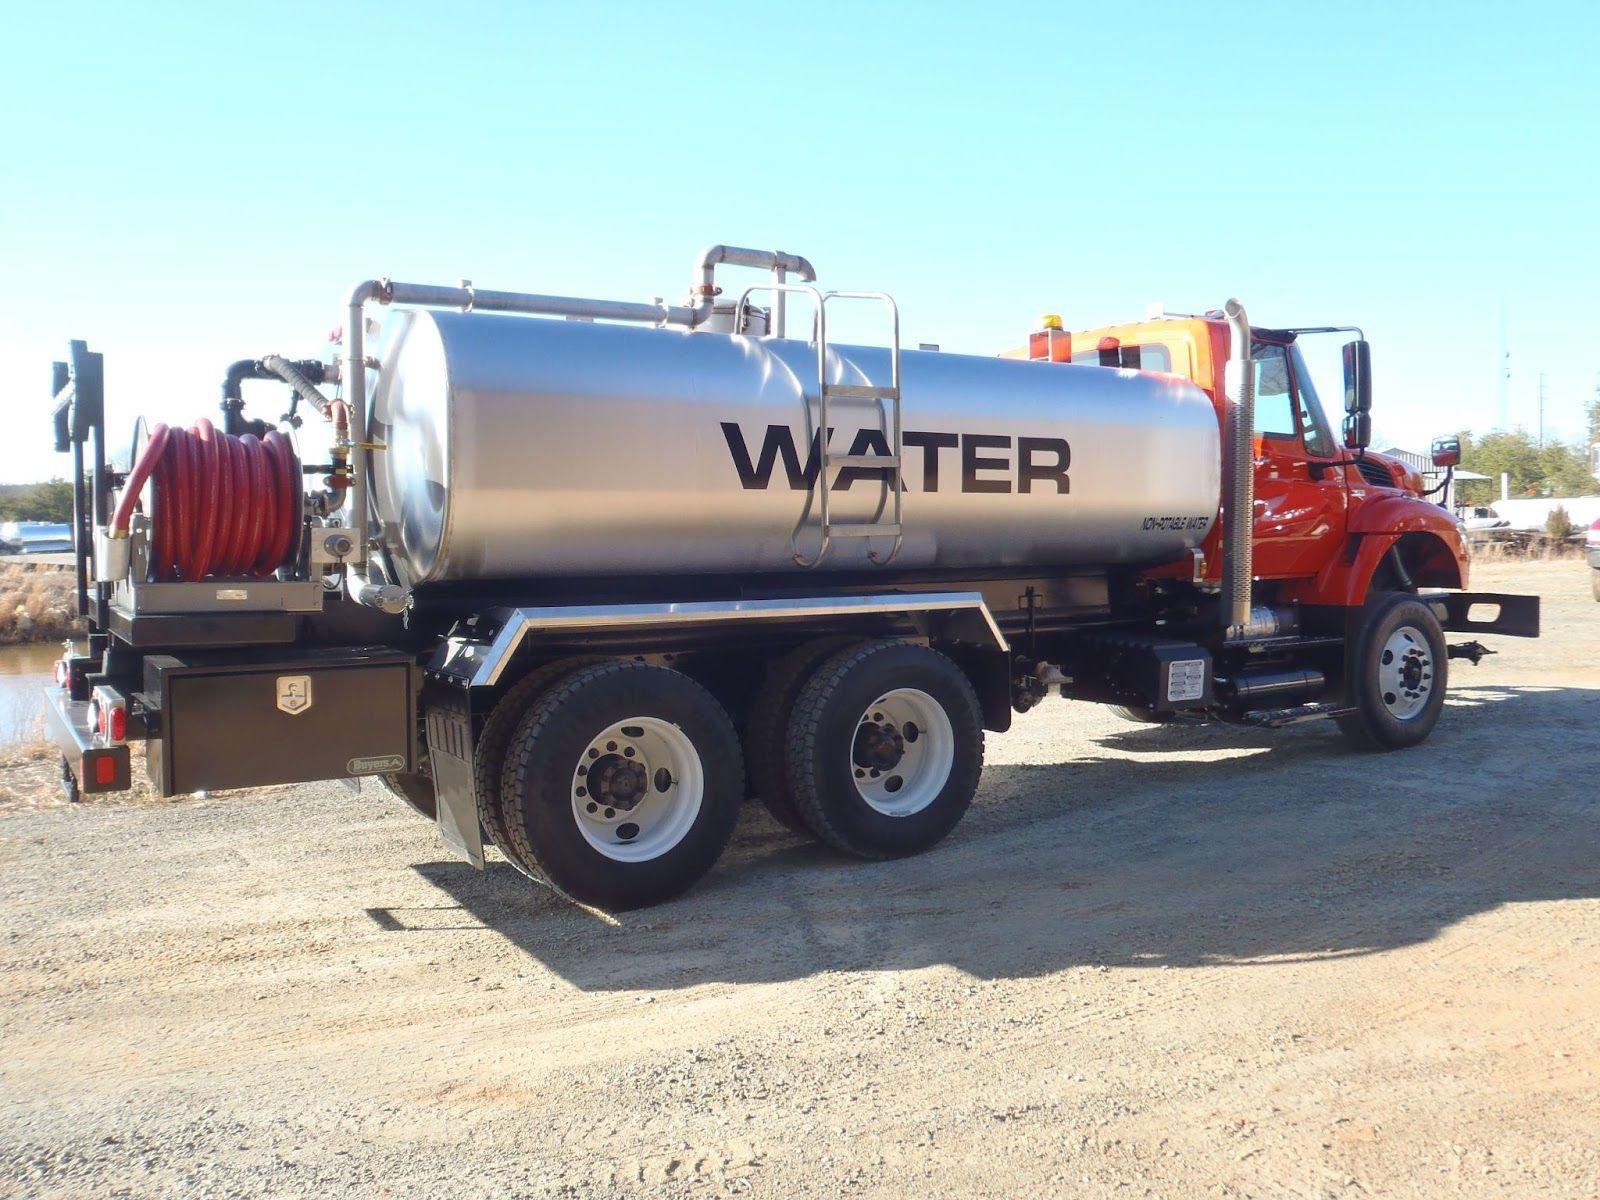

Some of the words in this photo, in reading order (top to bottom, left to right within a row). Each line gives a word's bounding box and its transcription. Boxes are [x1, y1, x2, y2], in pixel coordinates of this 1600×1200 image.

[720, 422, 1071, 494] WATER
[1142, 516, 1187, 531] NON-POTABLE
[1185, 516, 1209, 530] WATER
[353, 759, 390, 771] Buyers
